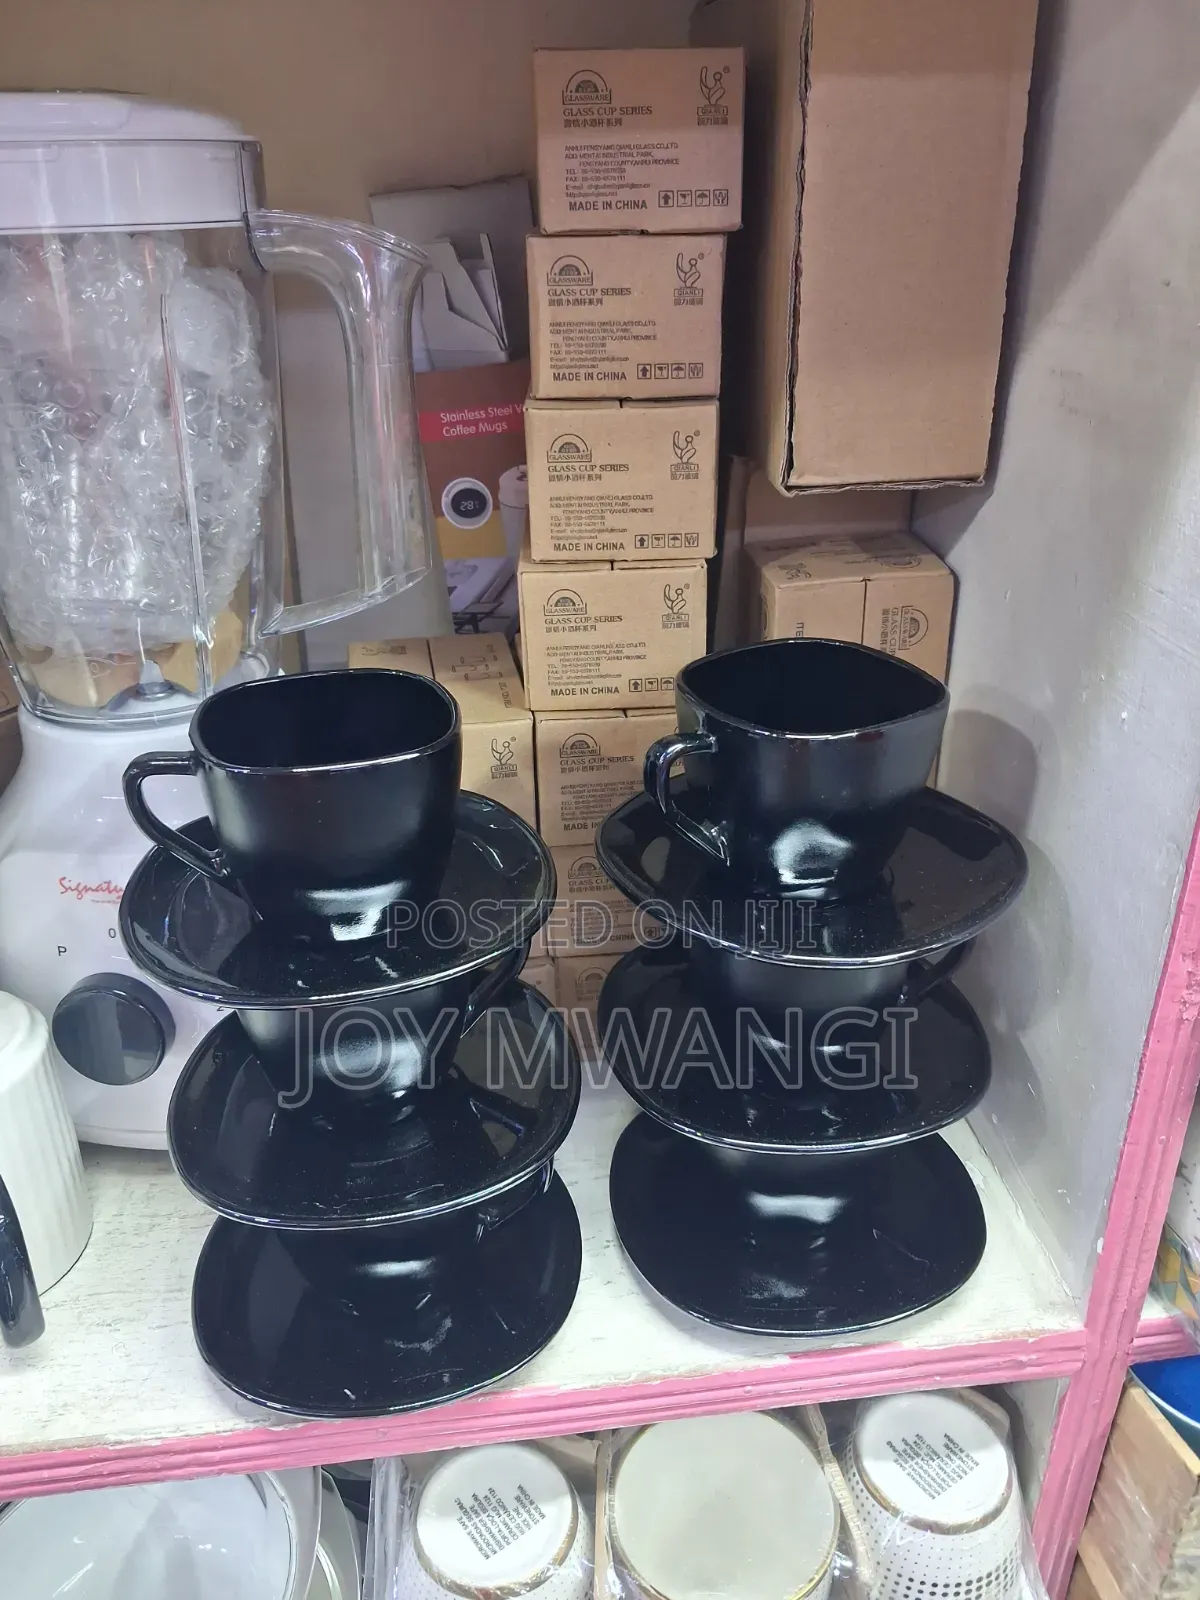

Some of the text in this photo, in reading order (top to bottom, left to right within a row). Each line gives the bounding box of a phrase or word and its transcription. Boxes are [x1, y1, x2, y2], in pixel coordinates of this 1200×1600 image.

[565, 94, 609, 102] GLASSWARE
[563, 105, 653, 117] GLASS CUP SERIES
[569, 200, 648, 211] MADE IN CHINA
[548, 289, 577, 297] GLASS
[553, 372, 627, 381] MADE IN CHINA
[440, 409, 486, 423] Stainless
[487, 406, 513, 418] Steel
[442, 421, 508, 437] Coffee Mugs
[579, 464, 597, 472] CUP
[553, 542, 625, 551] MADE IN CHINA
[574, 616, 592, 624] CUP
[594, 615, 622, 623] SERIES
[890, 607, 899, 636] GLASS
[796, 622, 804, 638] ITE
[551, 688, 577, 696] MADE
[580, 687, 588, 695] IN
[588, 757, 605, 765] CUP
[563, 822, 588, 831] MADE
[57, 945, 67, 957] P
[901, 1437, 921, 1457] SEGURA
[943, 1432, 959, 1448] CHINA
[943, 1441, 973, 1472] STONEWARE
[944, 1452, 968, 1475] NICE ONE
[964, 1452, 978, 1467] MADE
[902, 1447, 946, 1492] DISHWASHER SAFE
[934, 1461, 957, 1484] CERAMIC
[950, 1468, 962, 1480] MUG
[893, 1457, 935, 1500] MICROWAVE SAFE
[908, 1463, 940, 1496] MICROONDAS
[488, 1487, 497, 1497] 1124
[517, 1484, 530, 1500] CHINA
[470, 1493, 488, 1513] SEGURA
[514, 1494, 538, 1524] STONEWARE
[483, 1495, 518, 1540] CERAMIC MUG 1124
[512, 1506, 523, 1518] ONE
[532, 1505, 545, 1519] MADE
[468, 1504, 504, 1550] DISHWASHER SAFE
[456, 1516, 490, 1559] MICROWAVE SAFE
[470, 1521, 497, 1555] MICROONDAS
